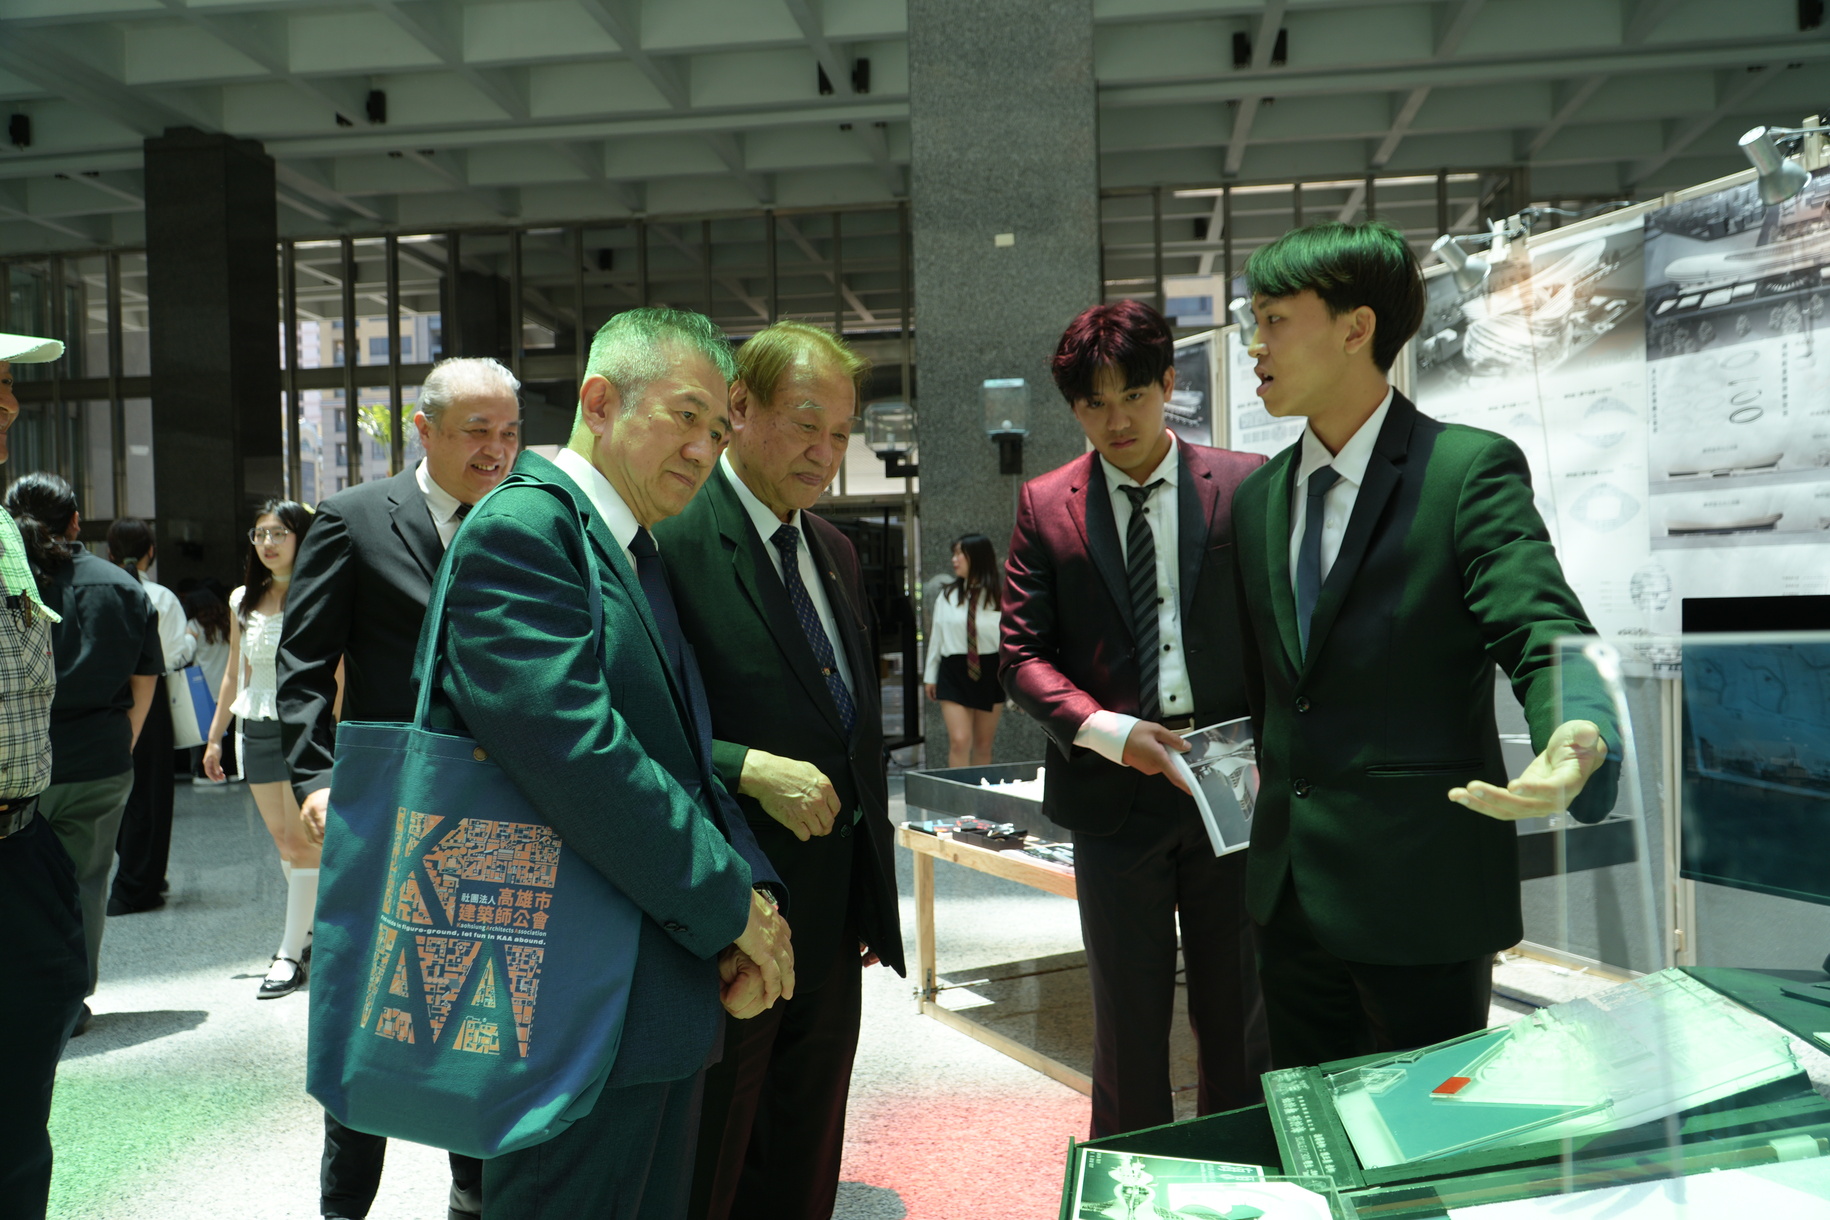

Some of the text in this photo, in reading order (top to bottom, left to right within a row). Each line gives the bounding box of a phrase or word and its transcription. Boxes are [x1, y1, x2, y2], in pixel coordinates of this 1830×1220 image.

[461, 887, 553, 910] 社團法人 高雄市
[457, 903, 550, 930] 建築師公會
[456, 922, 547, 937] Kaohsiung Architects Association
[496, 934, 512, 942] KAA
[514, 936, 546, 945] abound.
